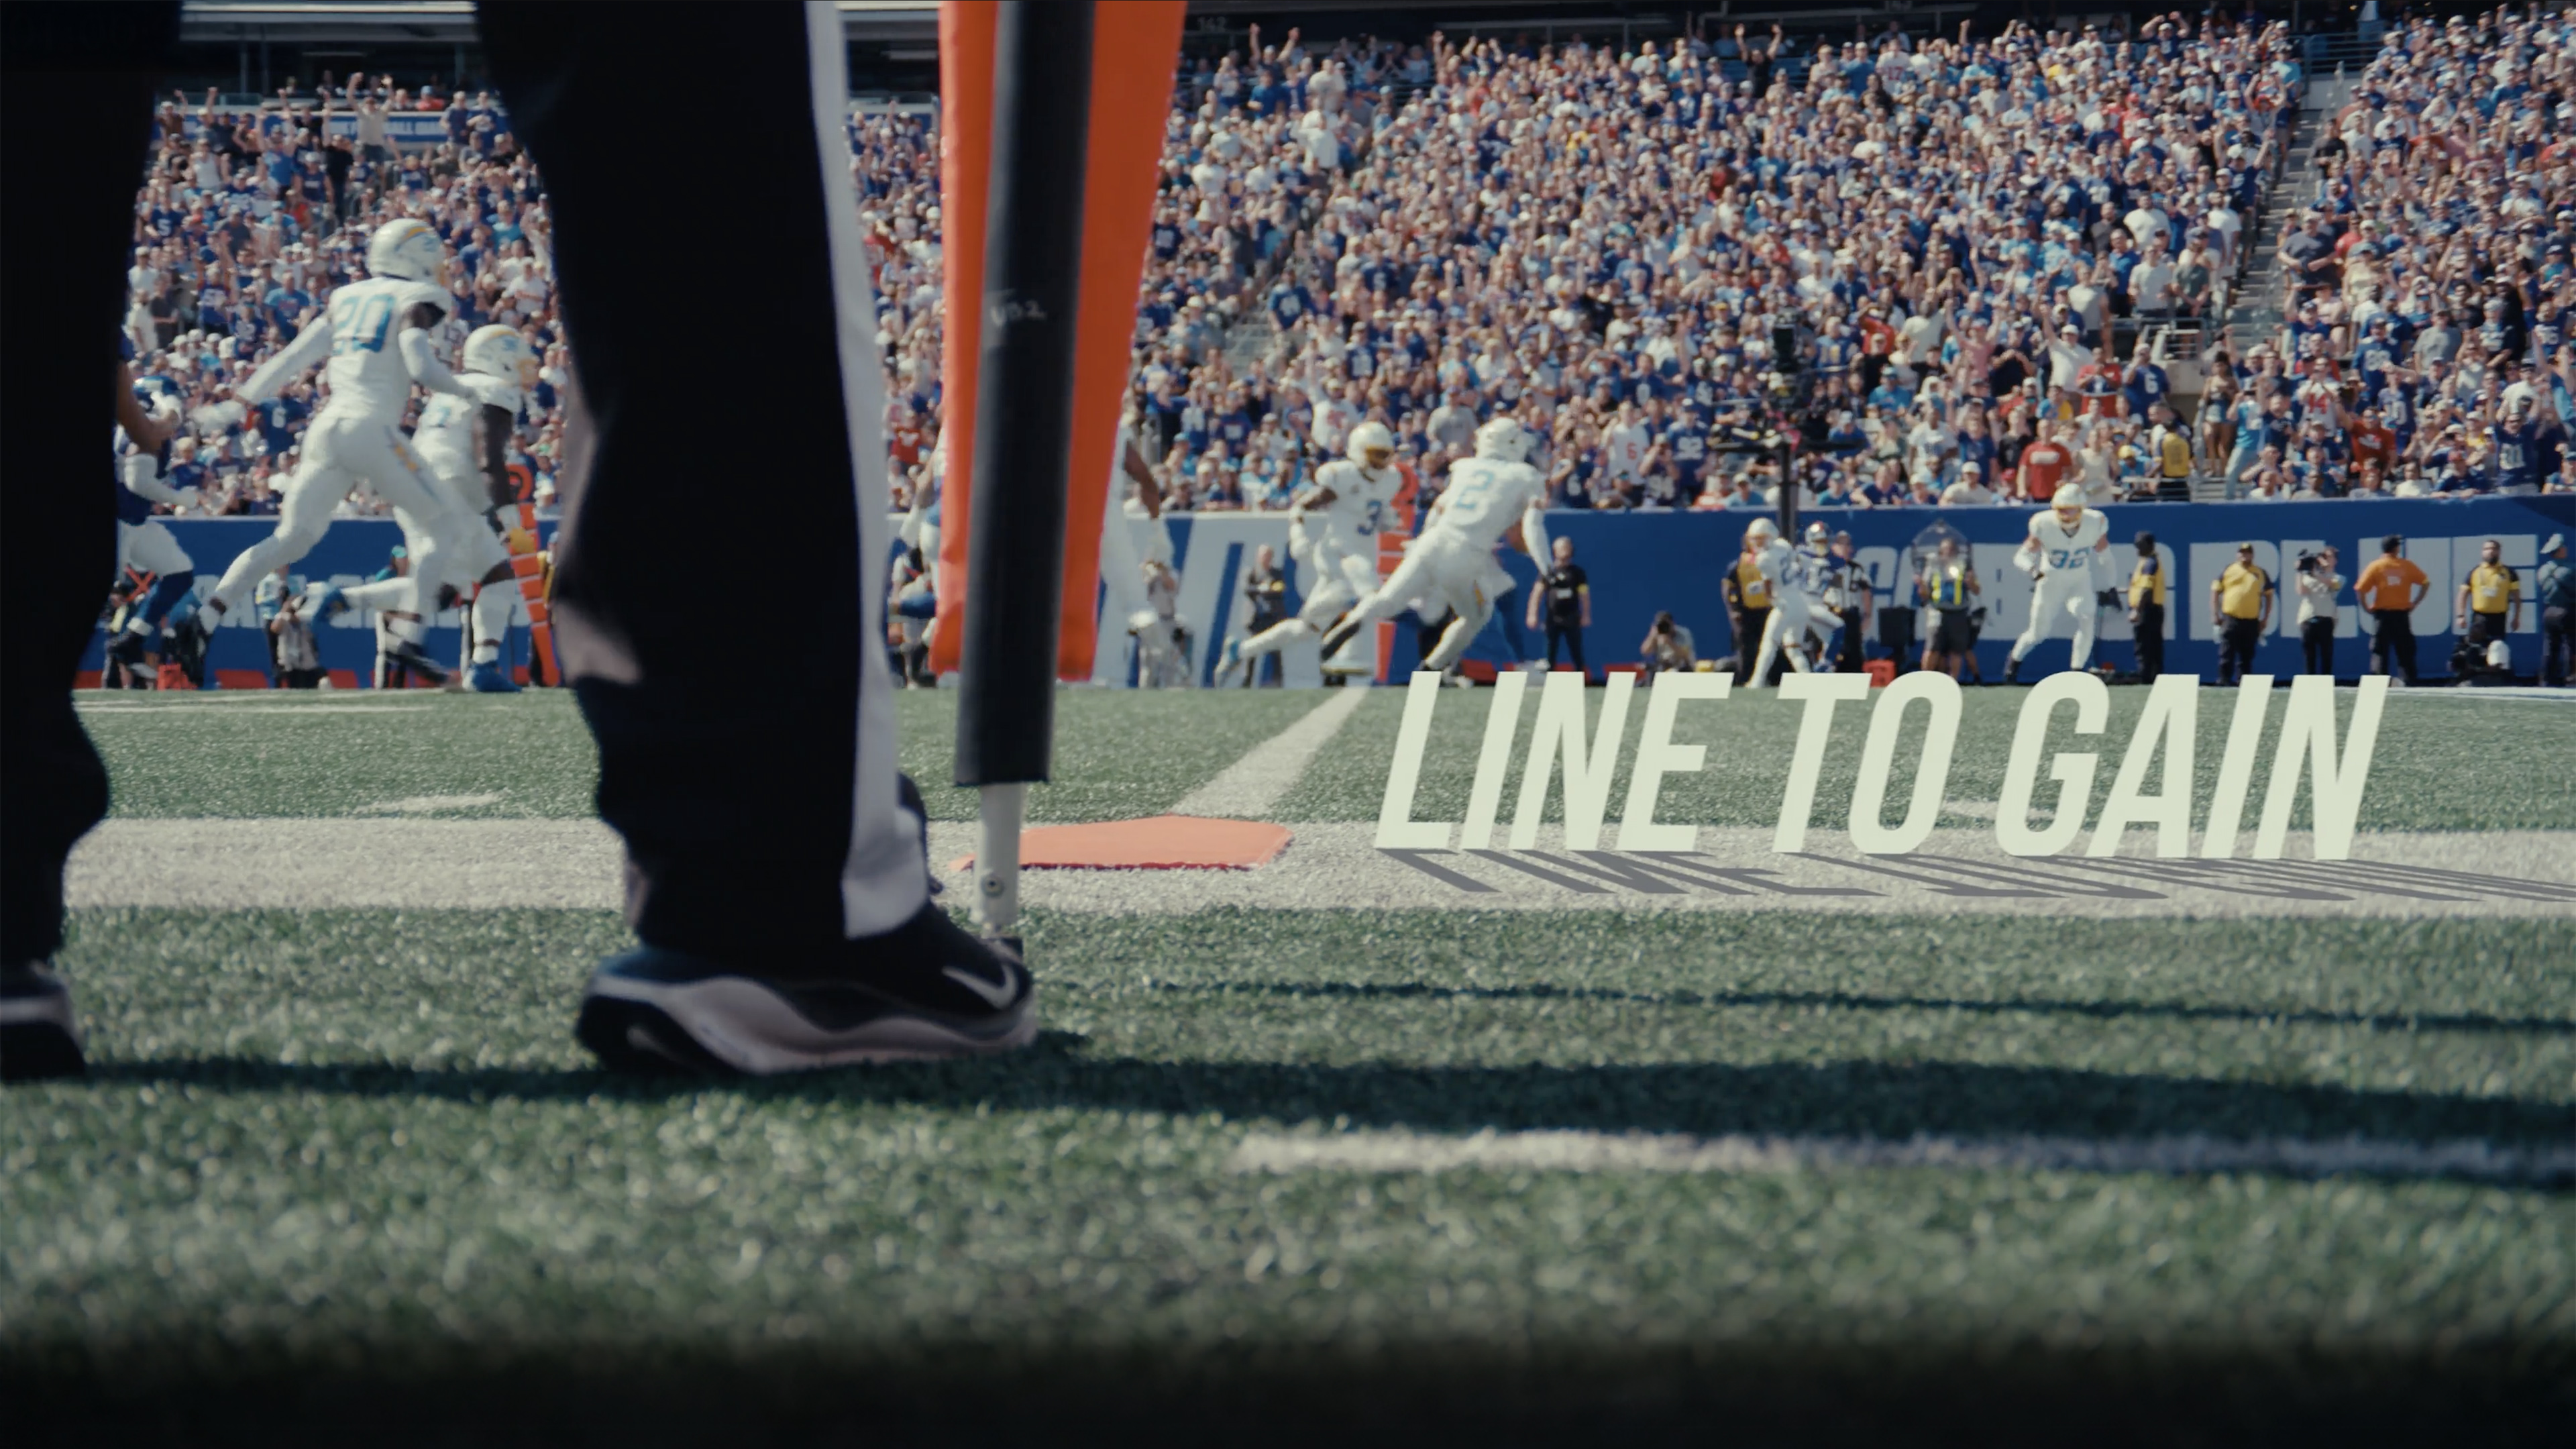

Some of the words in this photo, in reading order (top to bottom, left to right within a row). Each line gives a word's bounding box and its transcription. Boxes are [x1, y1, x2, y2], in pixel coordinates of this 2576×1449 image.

[332, 292, 397, 355] 20
[1456, 469, 1495, 511] 2
[2050, 547, 2090, 570] 32
